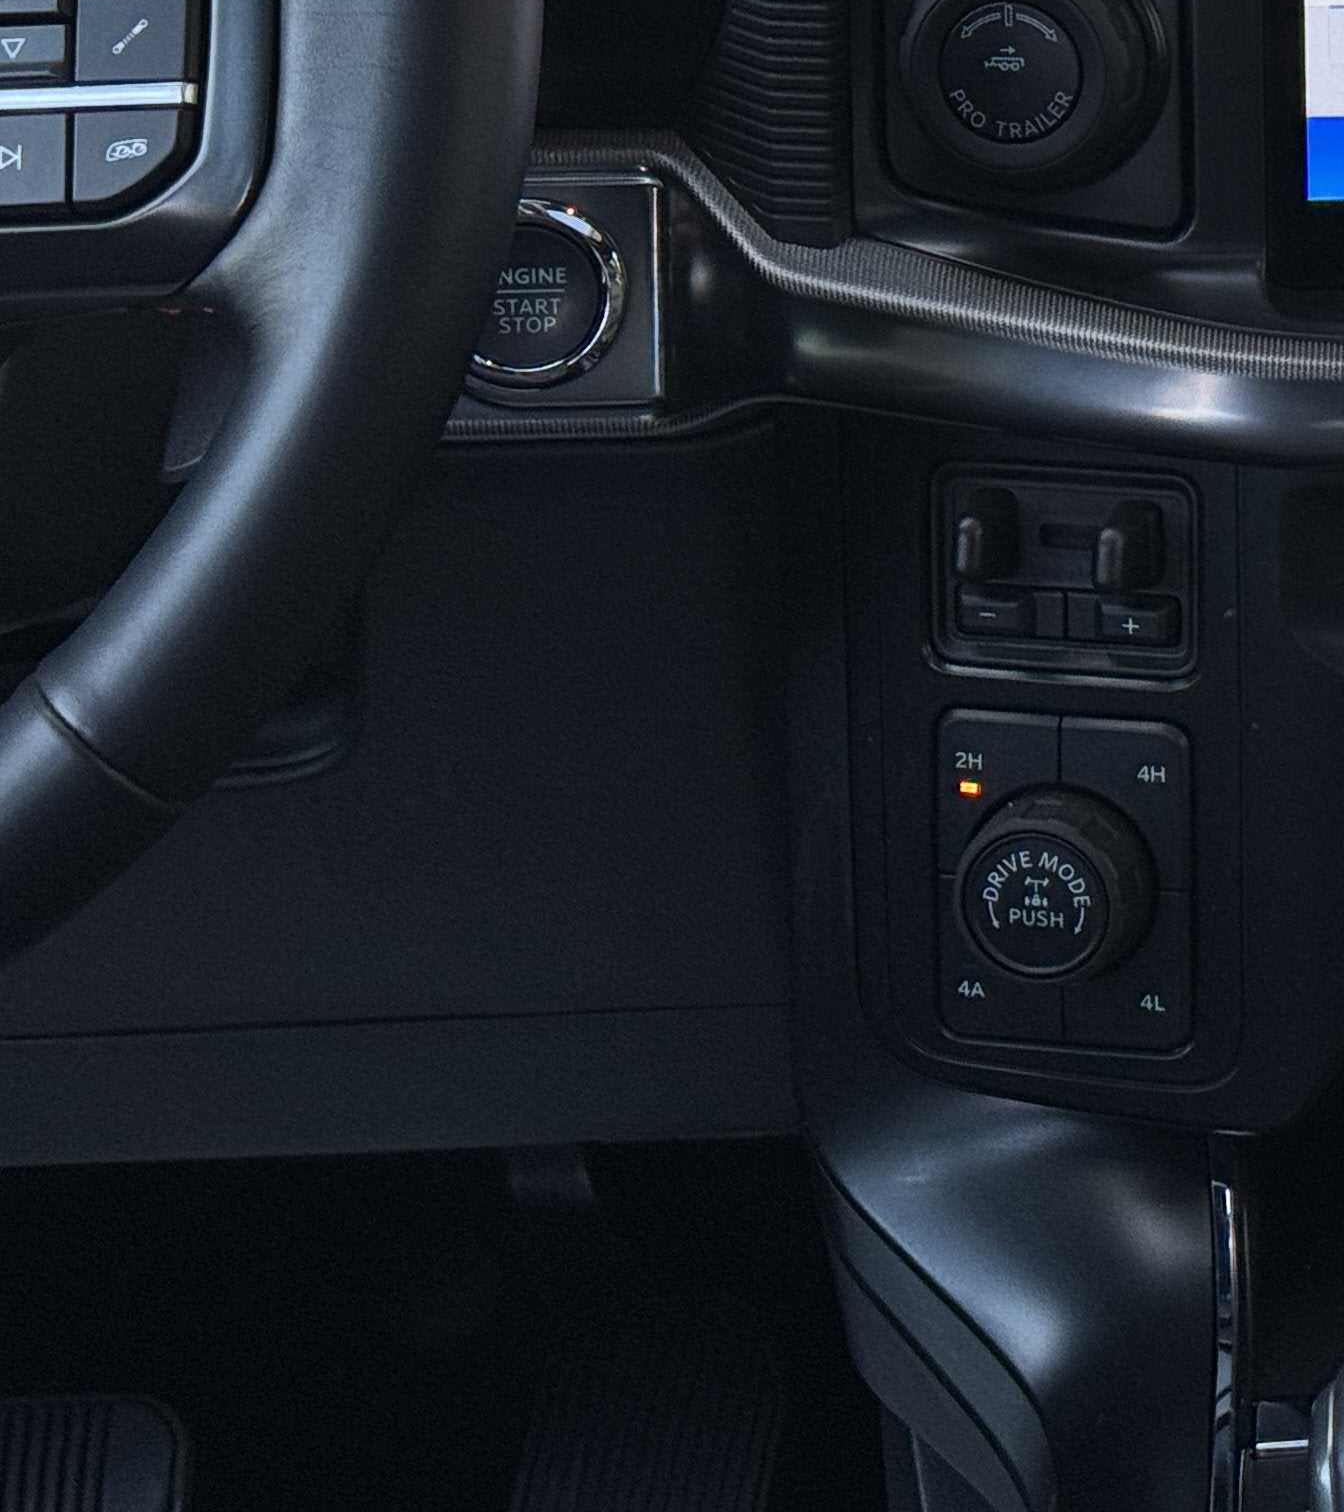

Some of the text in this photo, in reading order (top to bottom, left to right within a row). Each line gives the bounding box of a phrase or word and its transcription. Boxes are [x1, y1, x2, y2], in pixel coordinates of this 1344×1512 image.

[949, 88, 1073, 138] PRO TRAILER
[498, 267, 568, 285] NGINE
[492, 297, 562, 316] START
[499, 316, 557, 334] STOP
[954, 752, 983, 771] 2H
[1136, 765, 1167, 784] 4H
[981, 850, 1092, 908] DRIVE MODE
[1008, 907, 1065, 929] PUSH
[957, 980, 986, 998] 4A
[1140, 994, 1167, 1012] 4L
